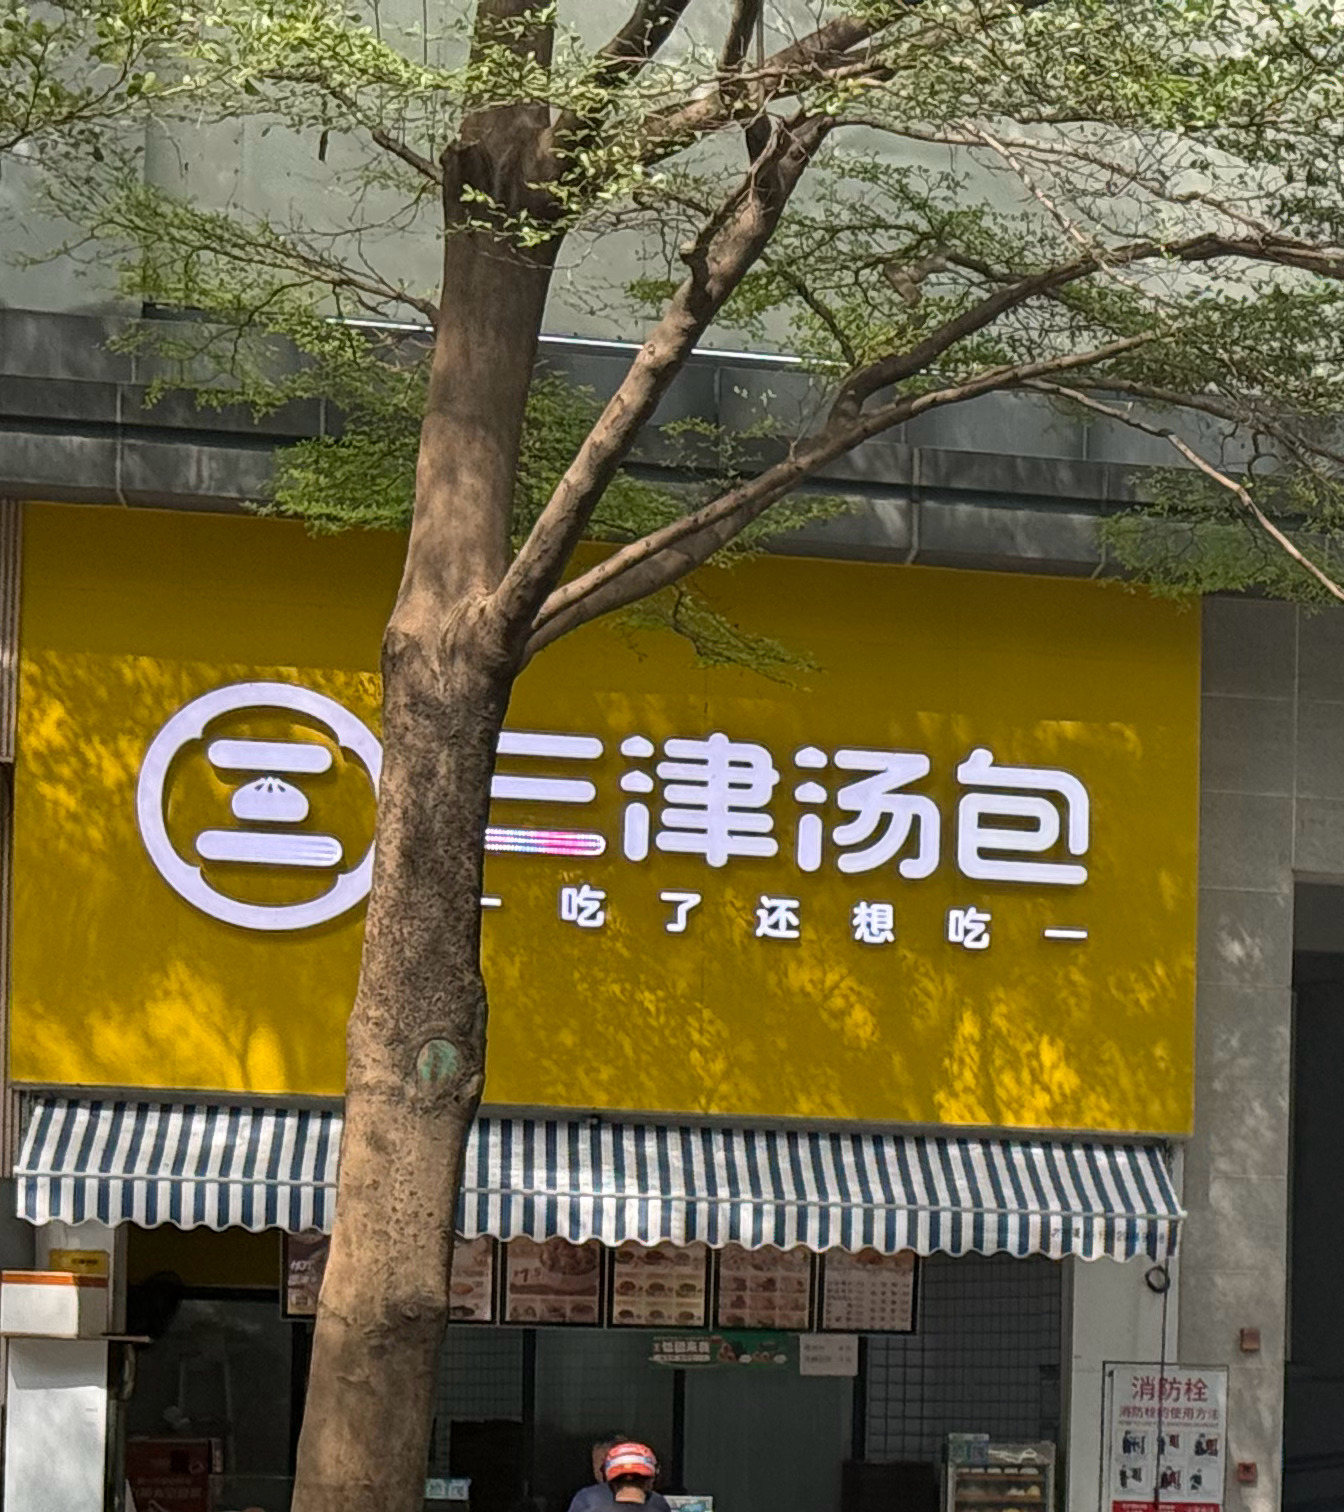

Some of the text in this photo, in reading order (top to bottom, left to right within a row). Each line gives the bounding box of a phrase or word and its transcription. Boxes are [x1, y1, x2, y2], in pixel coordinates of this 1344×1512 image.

[484, 732, 1090, 884] 三津汤包
[561, 884, 991, 950] 吃了还想吃
[1131, 1376, 1209, 1403] 消防栓
